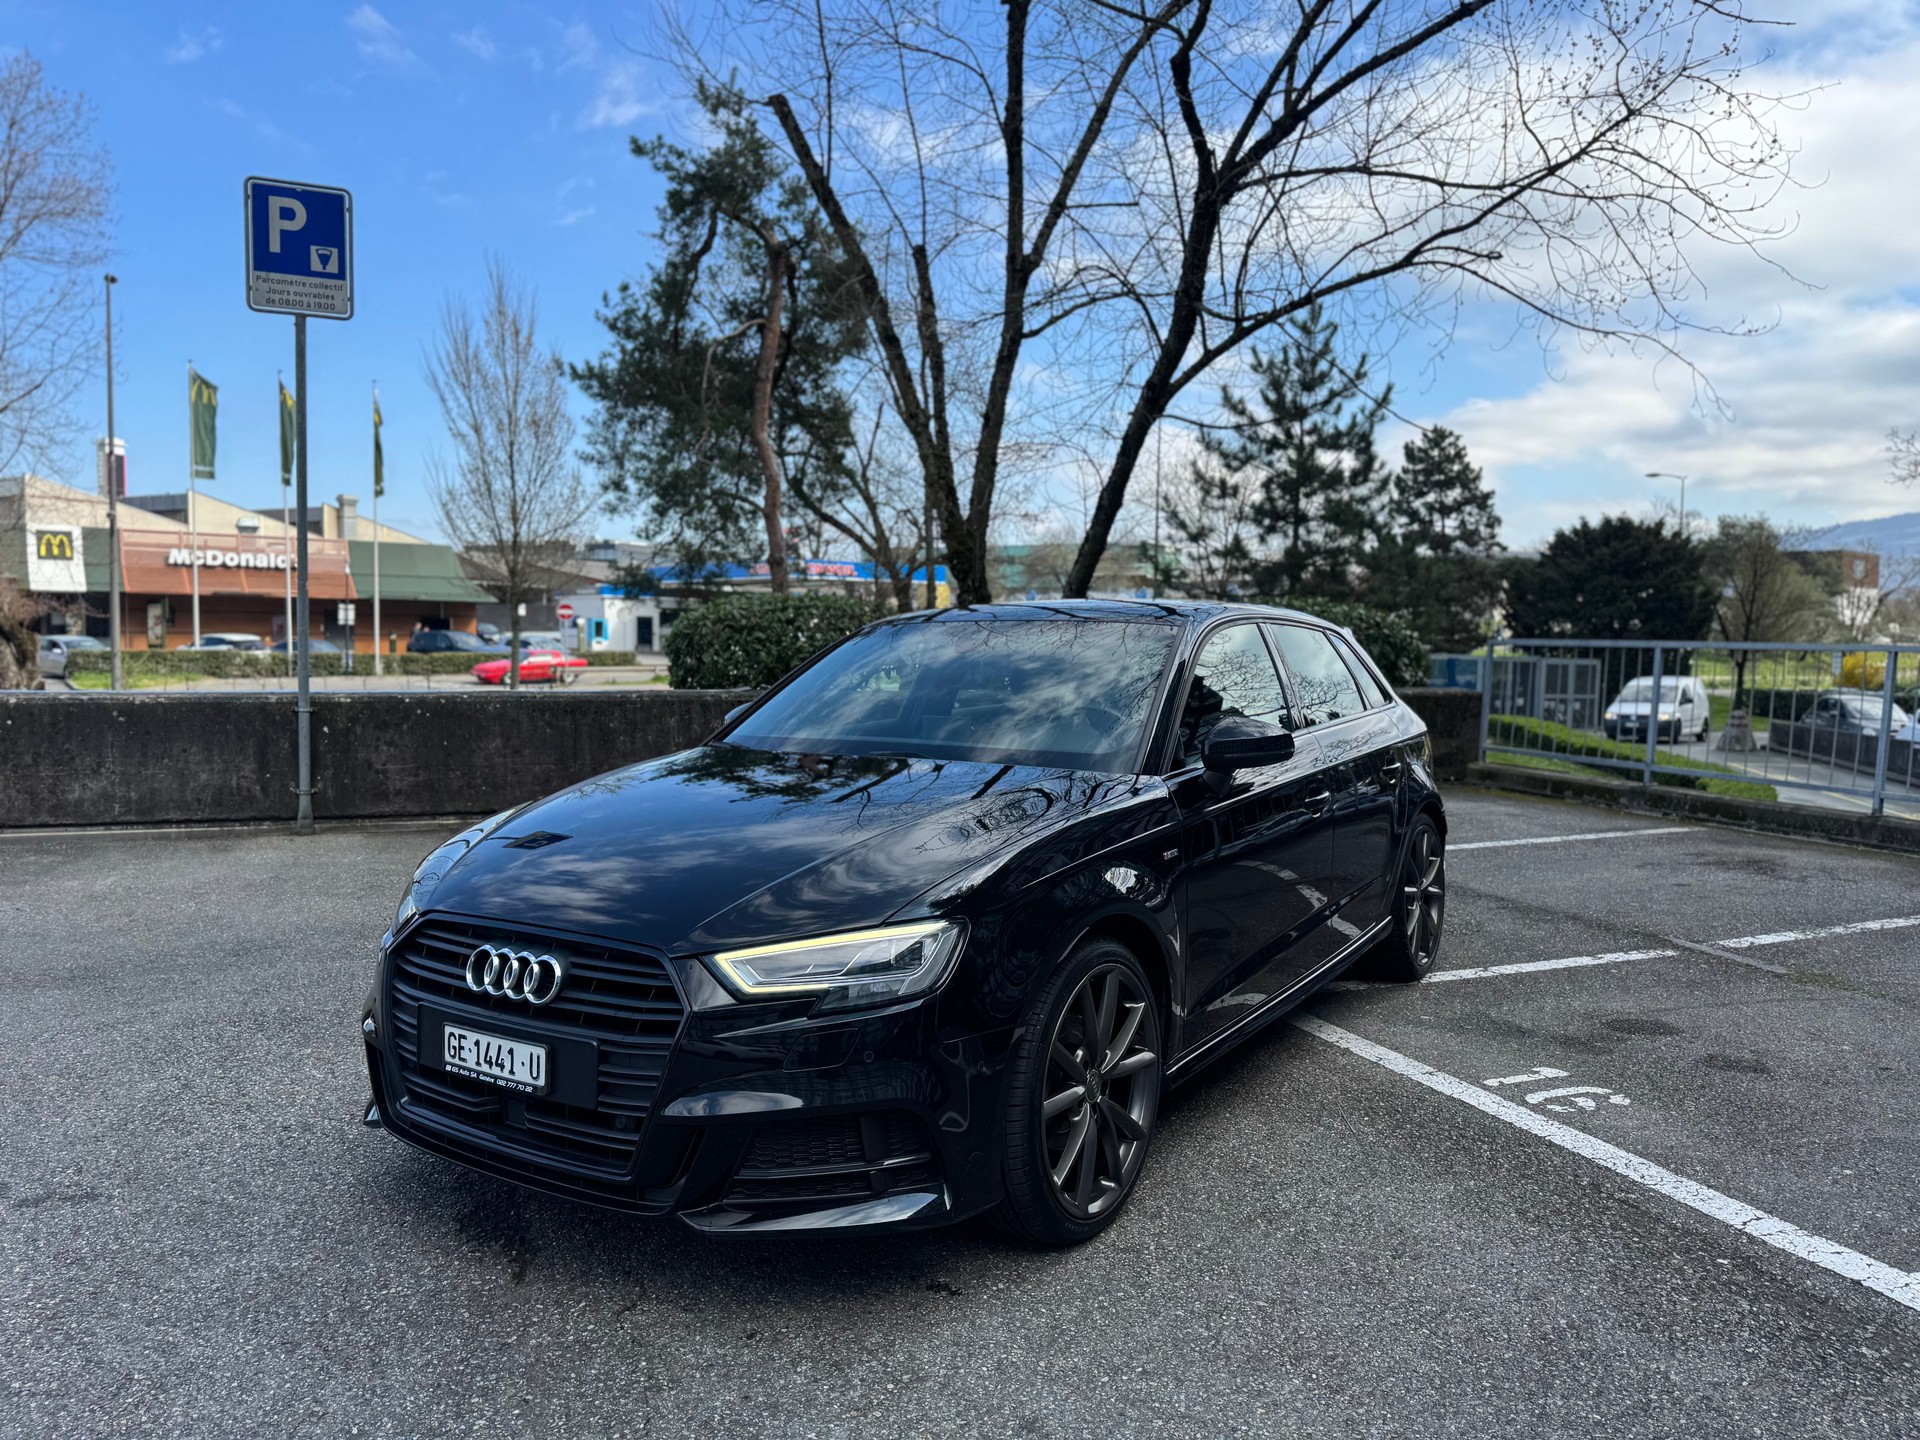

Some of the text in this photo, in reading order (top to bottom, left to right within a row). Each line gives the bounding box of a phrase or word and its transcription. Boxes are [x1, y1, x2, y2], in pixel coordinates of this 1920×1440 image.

[268, 195, 307, 253] P
[256, 275, 344, 292] Parcomètre collectif
[265, 297, 276, 305] de
[266, 287, 335, 301] Jours ouvrables
[459, 1068, 469, 1076] Auto
[496, 1079, 507, 1087] 022
[507, 1081, 517, 1089] 777
[517, 1083, 525, 1091] 70
[525, 1085, 533, 1093] 22
